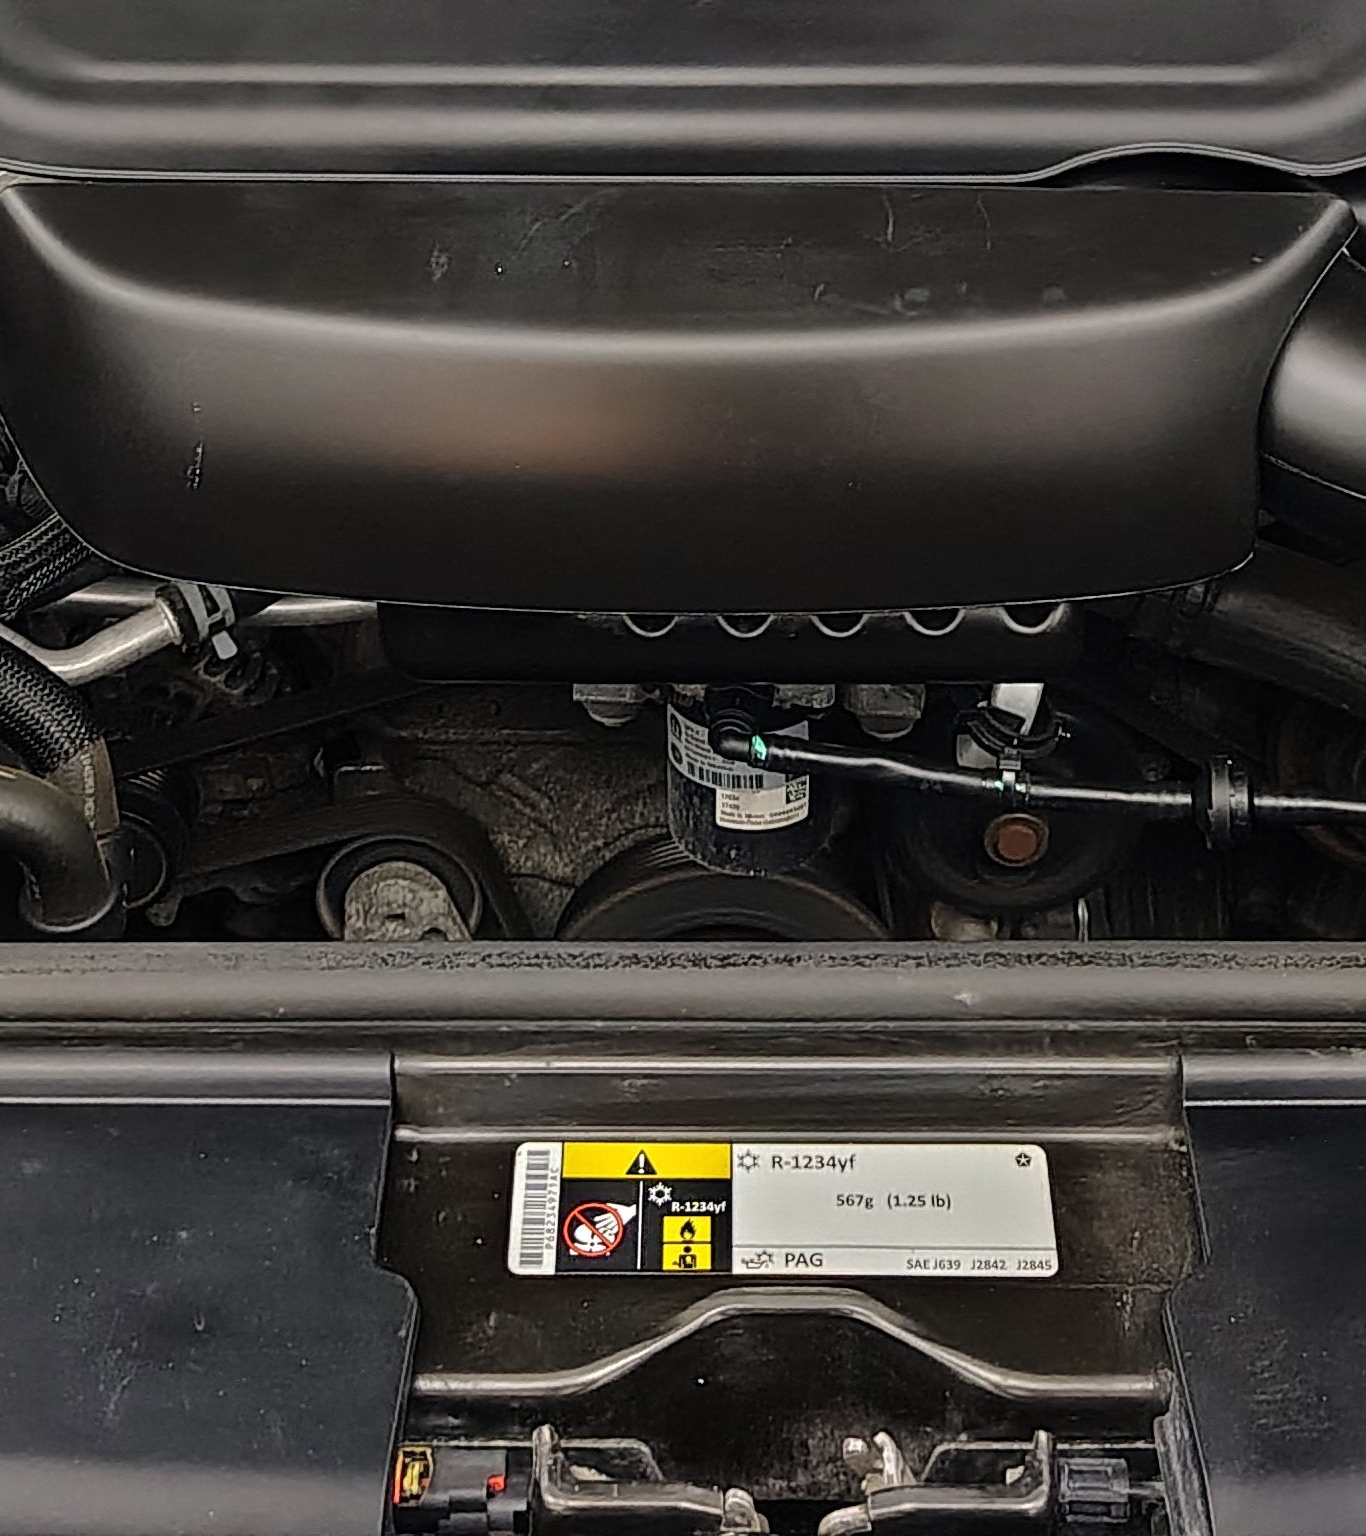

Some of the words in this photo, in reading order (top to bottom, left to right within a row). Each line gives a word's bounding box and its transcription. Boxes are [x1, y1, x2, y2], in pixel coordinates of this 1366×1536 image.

[771, 1154, 857, 1173] R-1234yf
[671, 1201, 727, 1214] R-1234yf
[836, 1194, 875, 1210] 567g
[887, 1193, 927, 1211] (1.25
[931, 1193, 952, 1211] lb)
[785, 1252, 824, 1269] PAG
[906, 1259, 931, 1271] SAE
[933, 1259, 962, 1271] J639
[971, 1259, 1008, 1271] J2842
[1016, 1260, 1053, 1271] J2845
